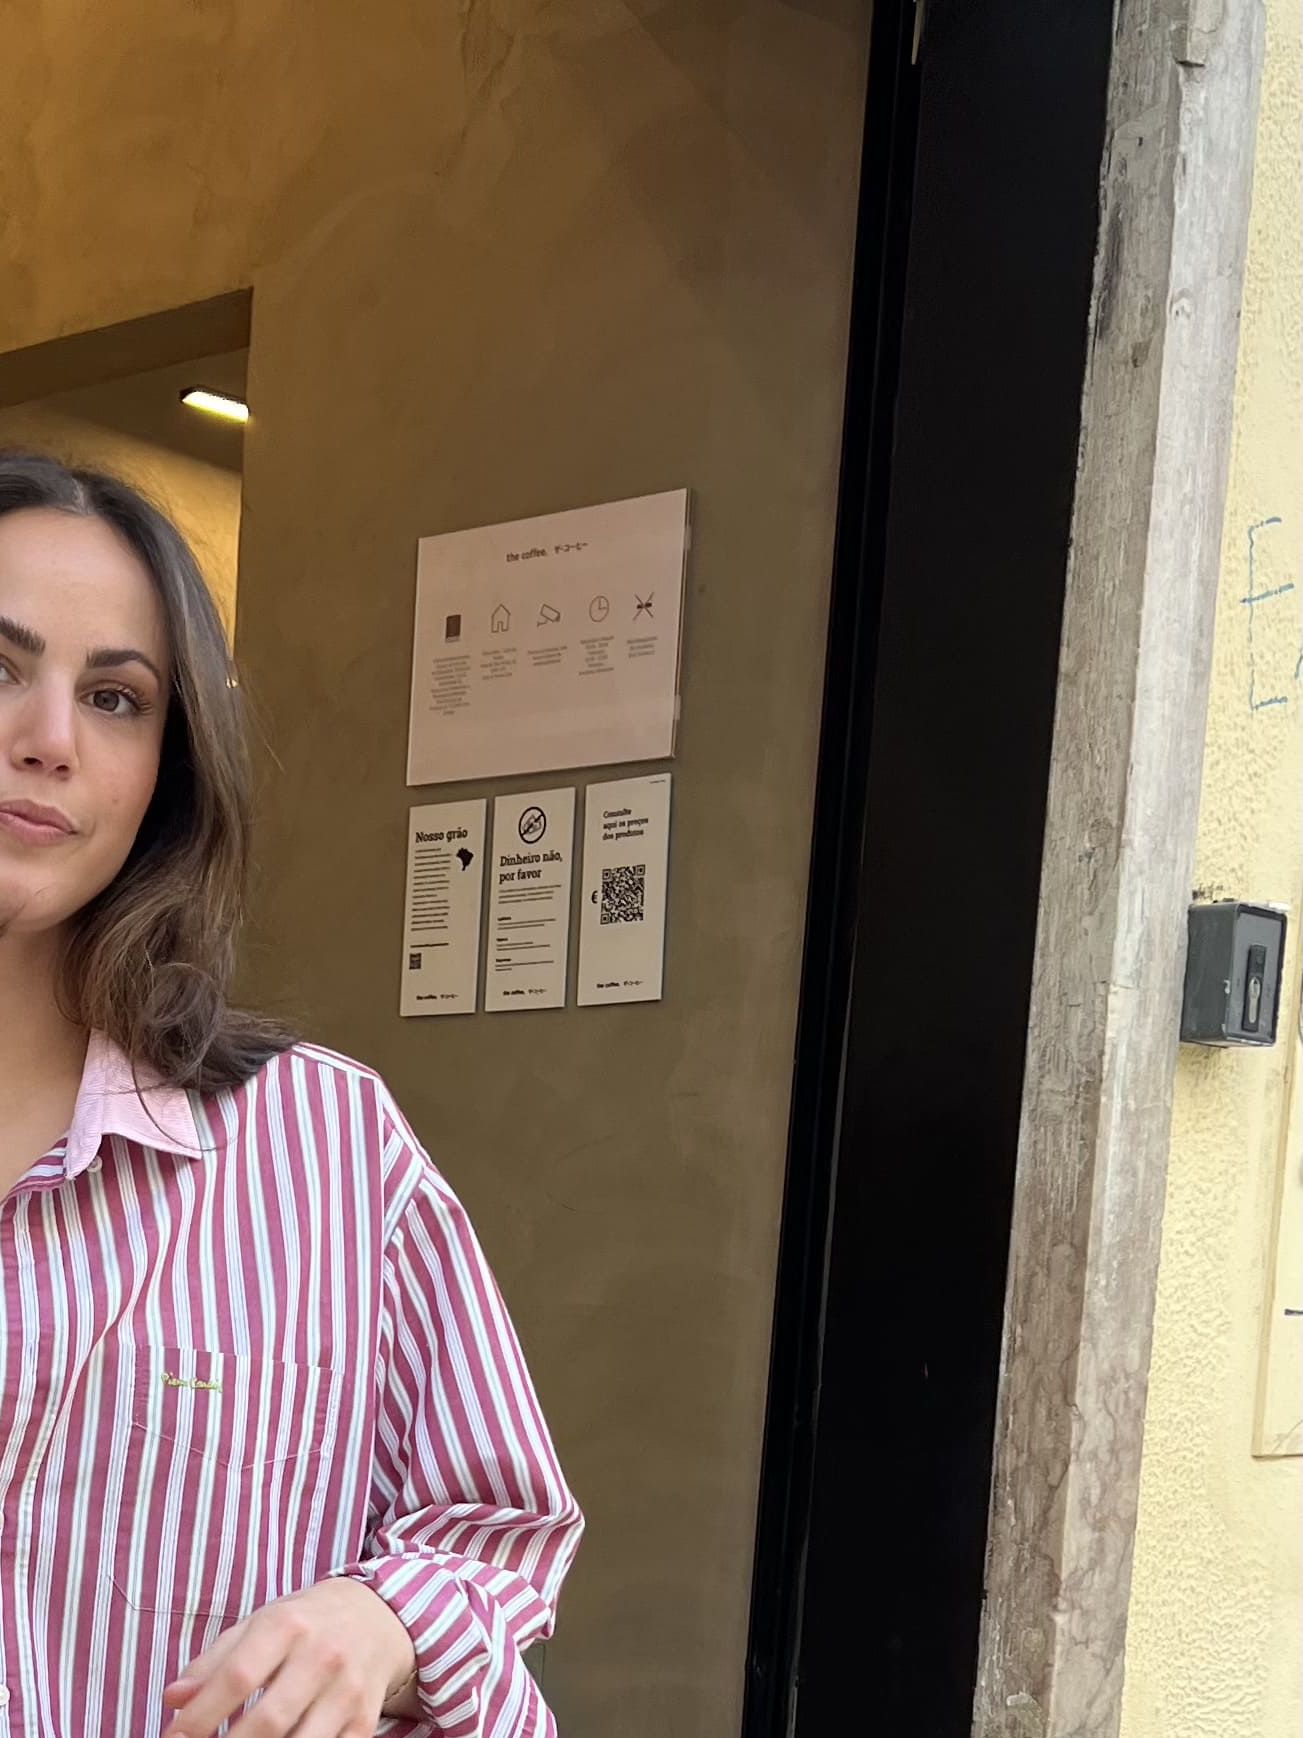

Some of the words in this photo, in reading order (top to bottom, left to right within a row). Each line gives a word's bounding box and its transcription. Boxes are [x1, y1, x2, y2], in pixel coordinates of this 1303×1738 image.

[603, 808, 632, 819] Consulte
[415, 831, 444, 843] Nosso
[446, 826, 468, 842] grão
[499, 853, 541, 867] Dinheiro
[542, 850, 563, 863] não,
[499, 871, 516, 884] por
[517, 868, 542, 880] favor
